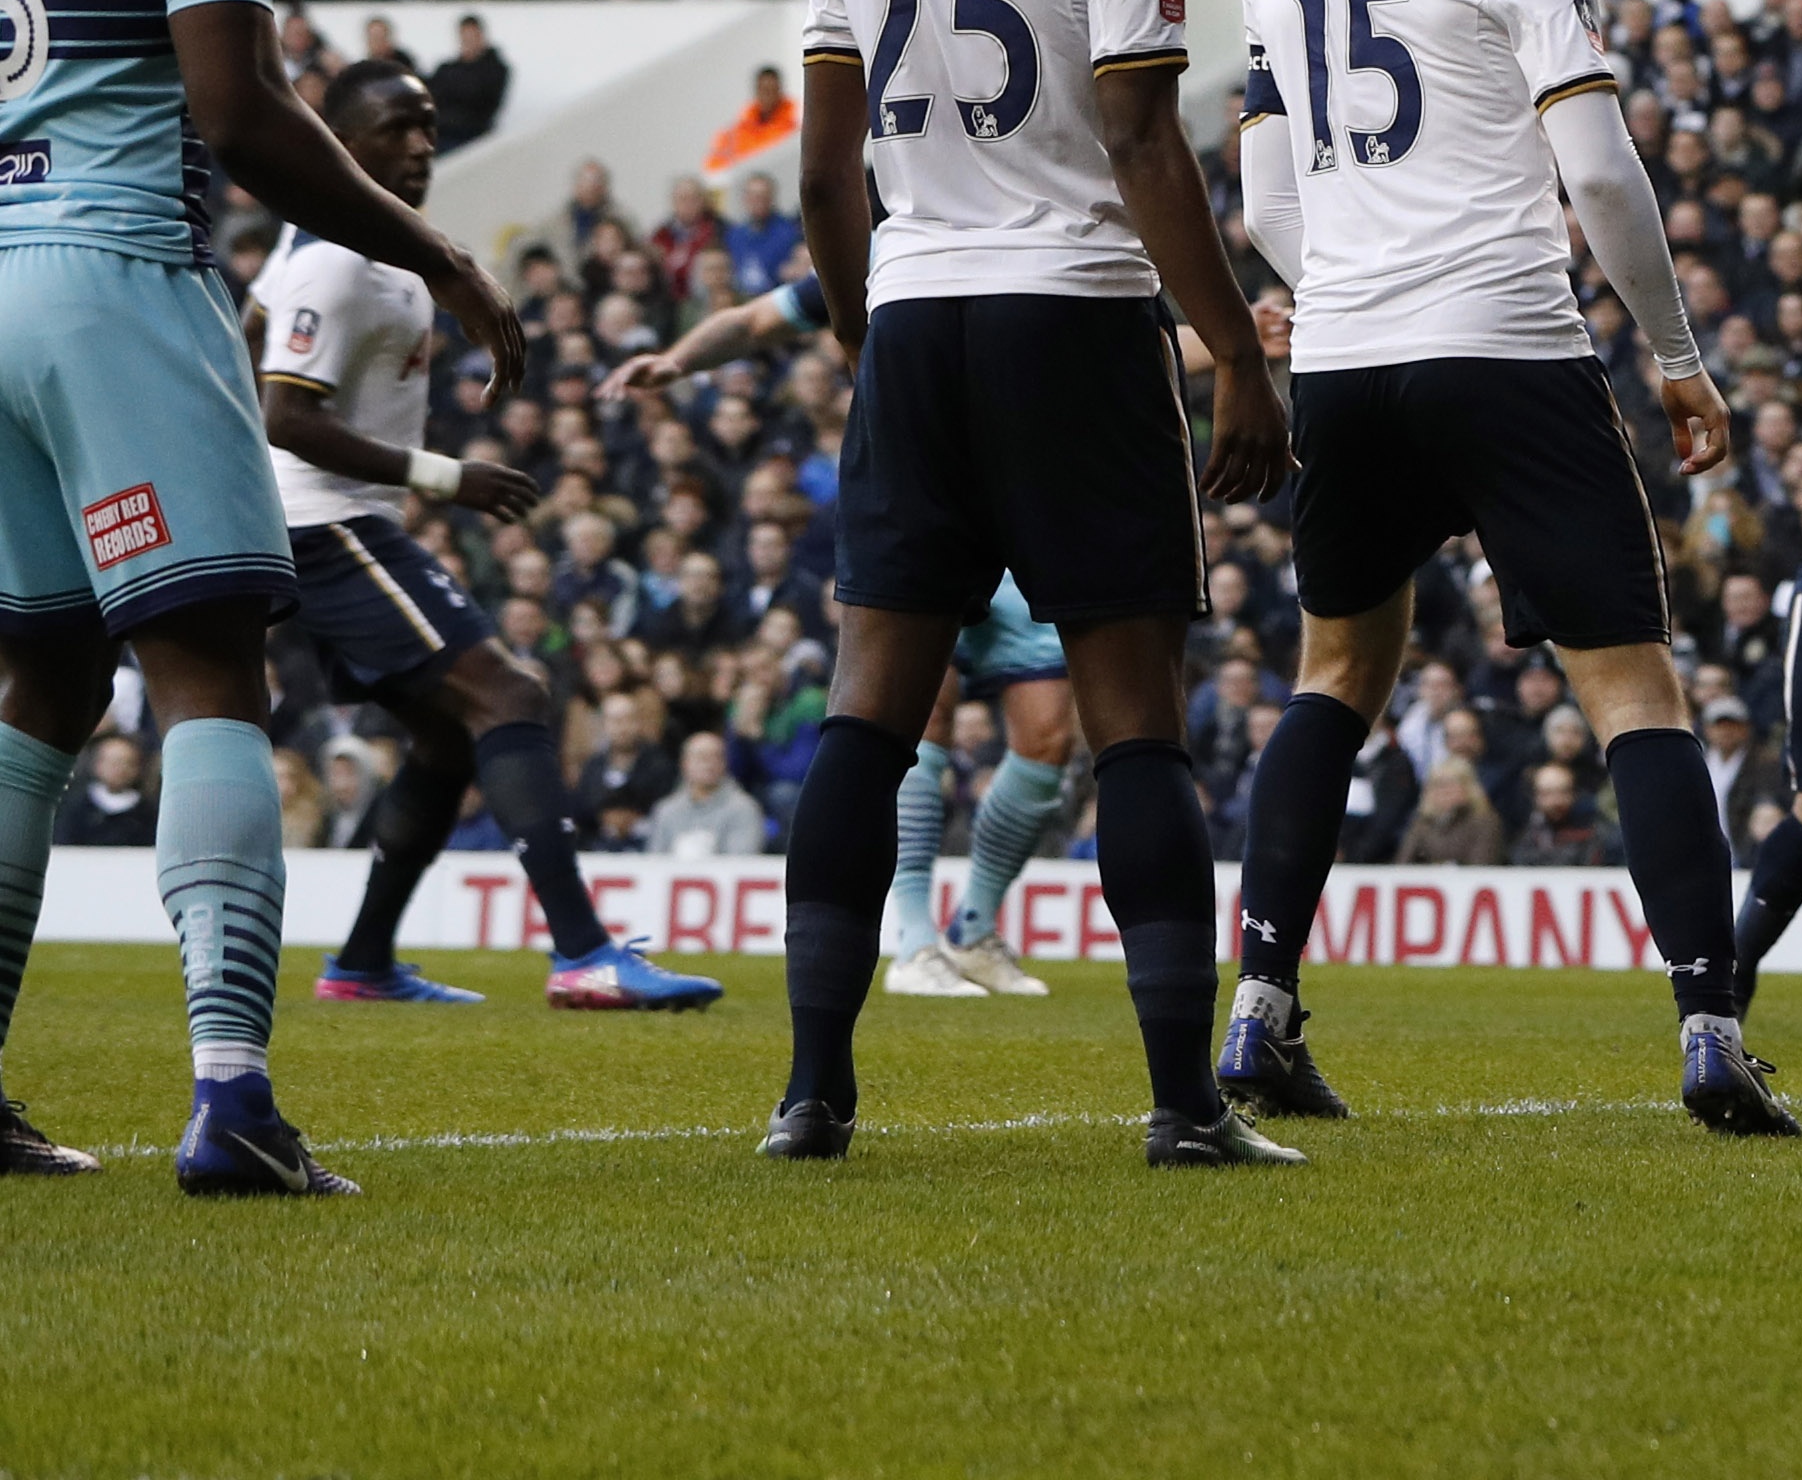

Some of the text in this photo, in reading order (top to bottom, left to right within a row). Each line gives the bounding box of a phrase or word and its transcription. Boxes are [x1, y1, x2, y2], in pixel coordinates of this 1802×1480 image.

[120, 492, 151, 520] RED
[93, 516, 158, 564] RECORDS
[665, 877, 787, 953] RE
[1226, 885, 1653, 967] MPANY
